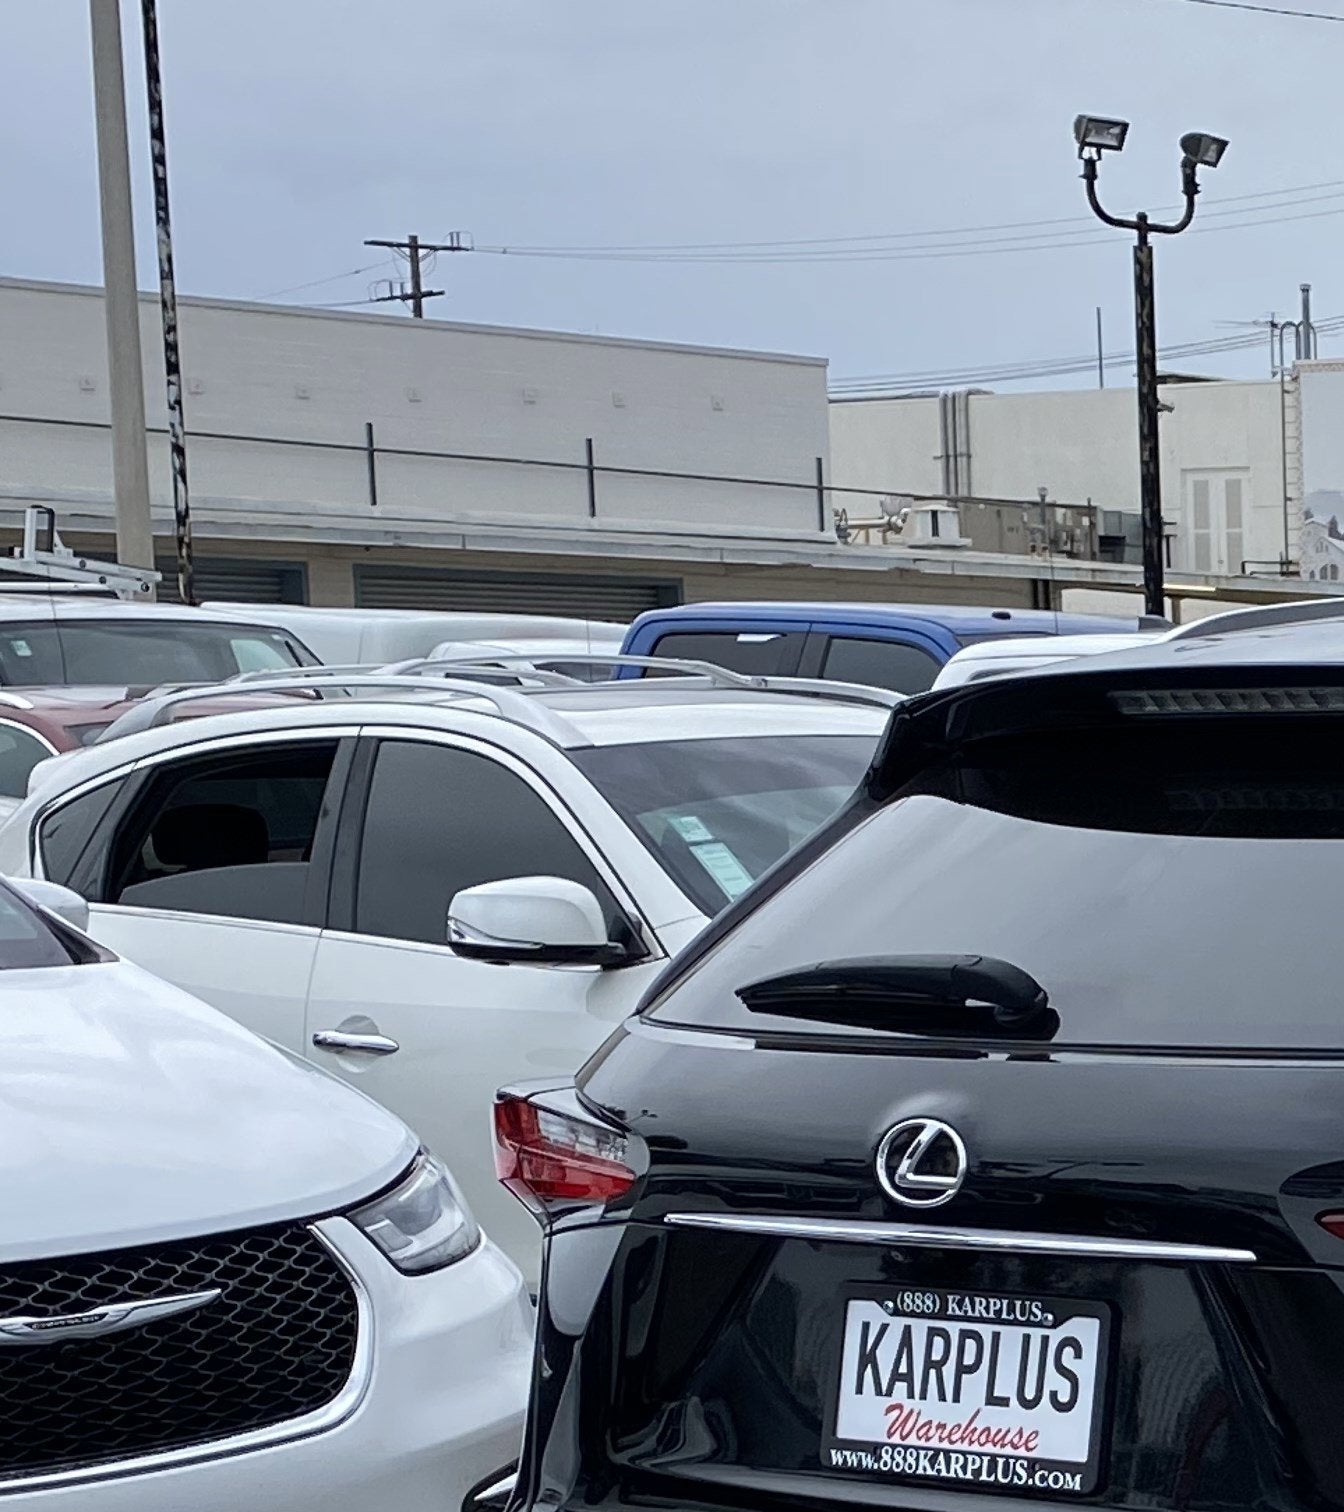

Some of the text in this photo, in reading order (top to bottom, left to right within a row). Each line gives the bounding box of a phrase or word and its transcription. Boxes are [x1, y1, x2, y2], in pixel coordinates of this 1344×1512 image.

[896, 1291, 1042, 1323] (888) KARPLUS
[854, 1320, 1084, 1414] KARPLUS
[883, 1402, 1039, 1453] Warehouse
